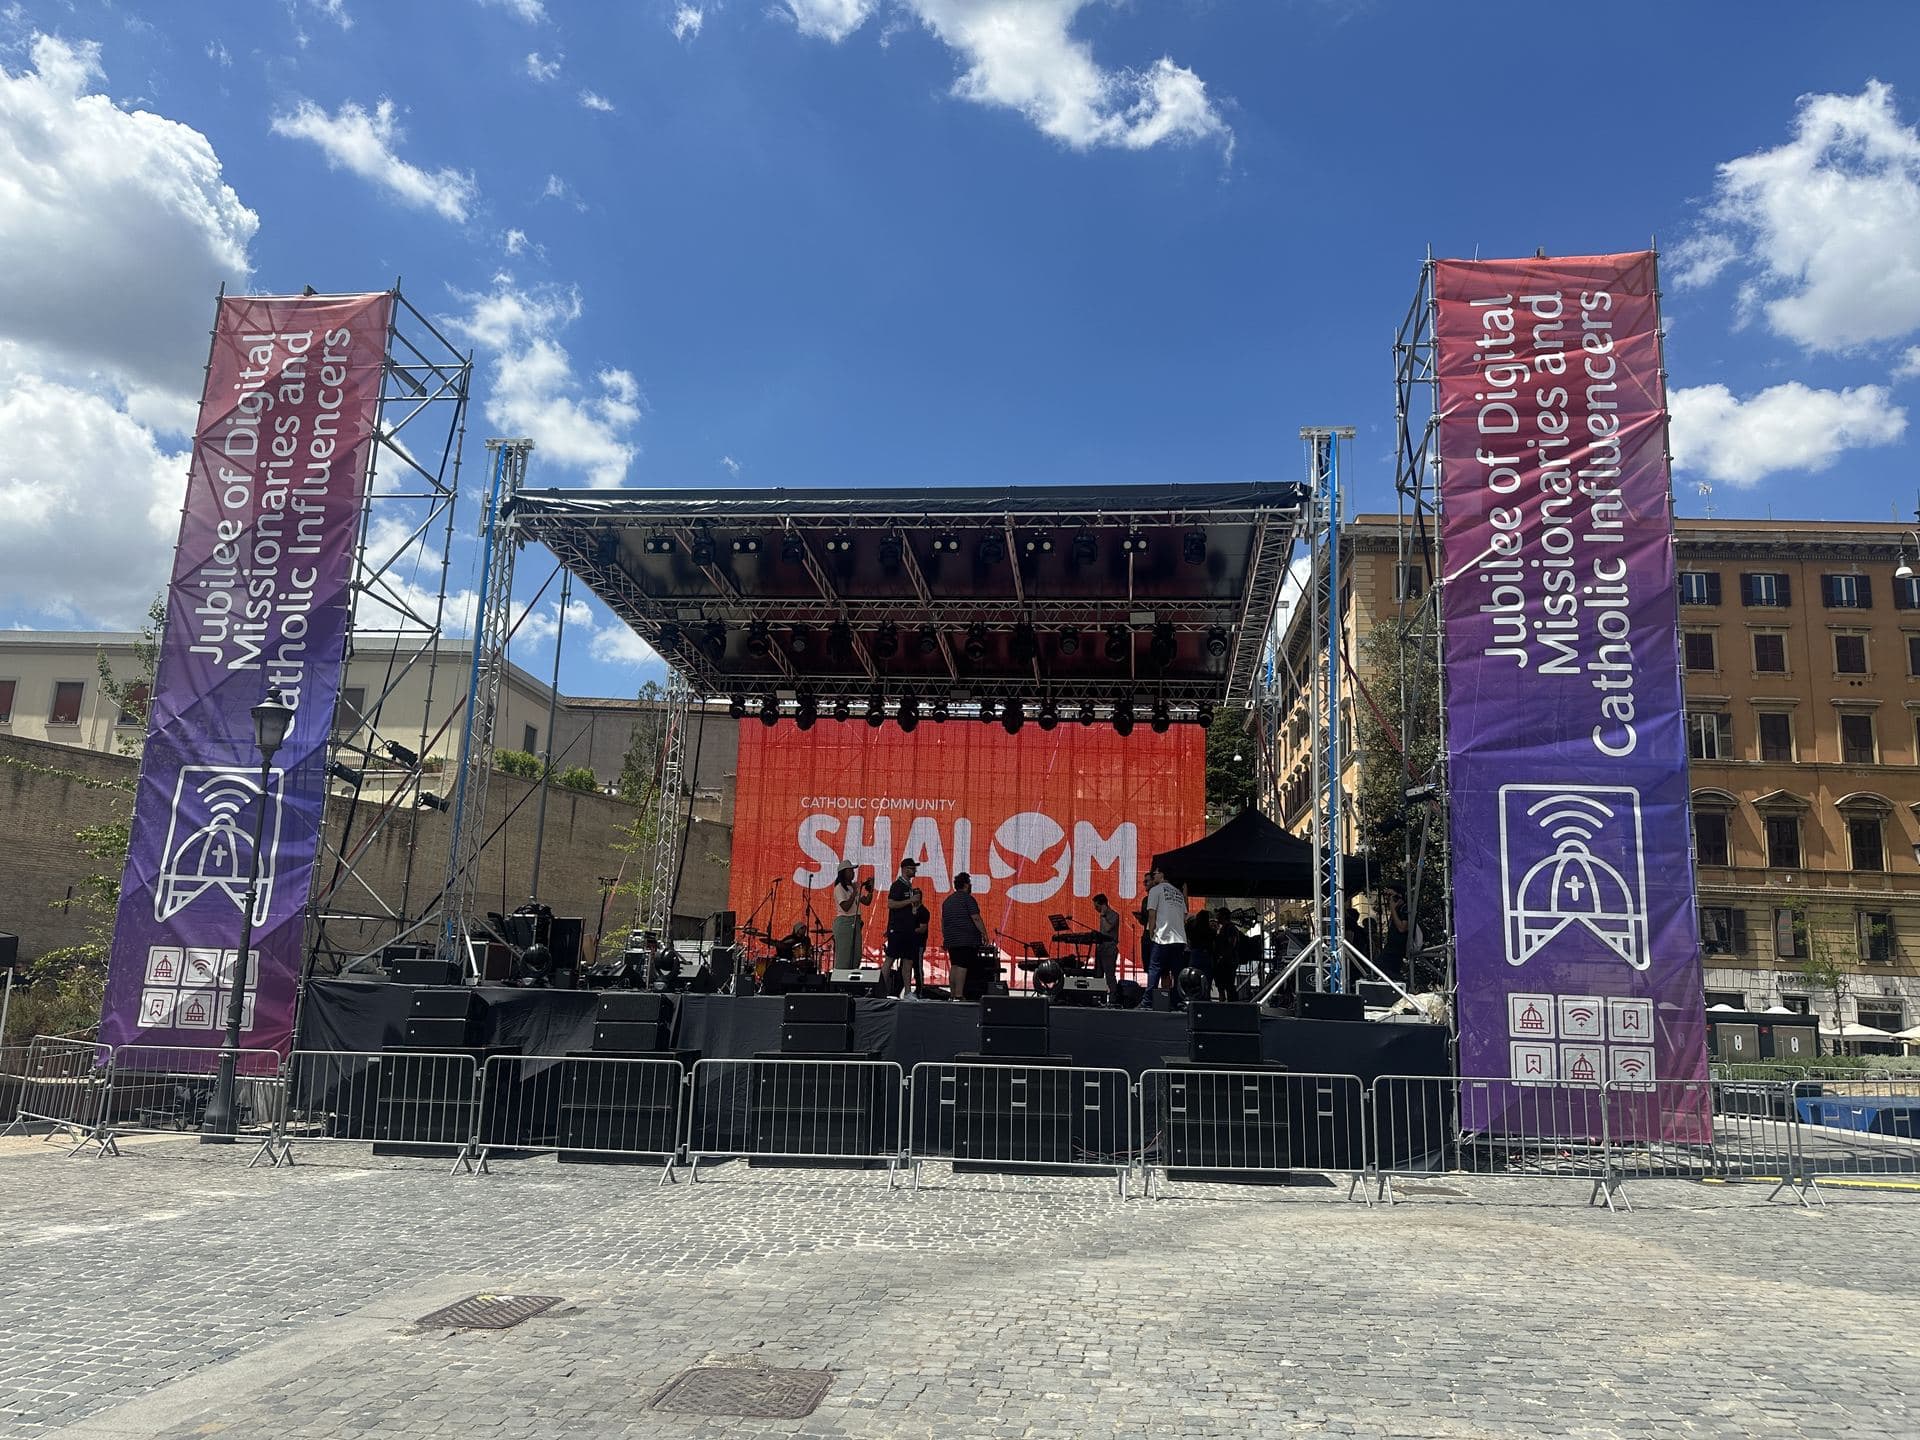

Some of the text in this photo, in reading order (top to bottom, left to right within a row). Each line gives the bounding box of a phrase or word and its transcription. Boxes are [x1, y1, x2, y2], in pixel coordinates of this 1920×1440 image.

[189, 332, 276, 664] Jubilee of Digital
[227, 329, 314, 671] Missionaries and
[288, 327, 351, 555] Influencers
[1469, 293, 1530, 669] Jubilee of Digital
[1520, 291, 1581, 676] Missionaries and
[1577, 290, 1638, 758] Catholic Influencers
[793, 812, 1138, 903] SHALOM
[801, 797, 956, 811] CATHOLIC COMMUNITY
